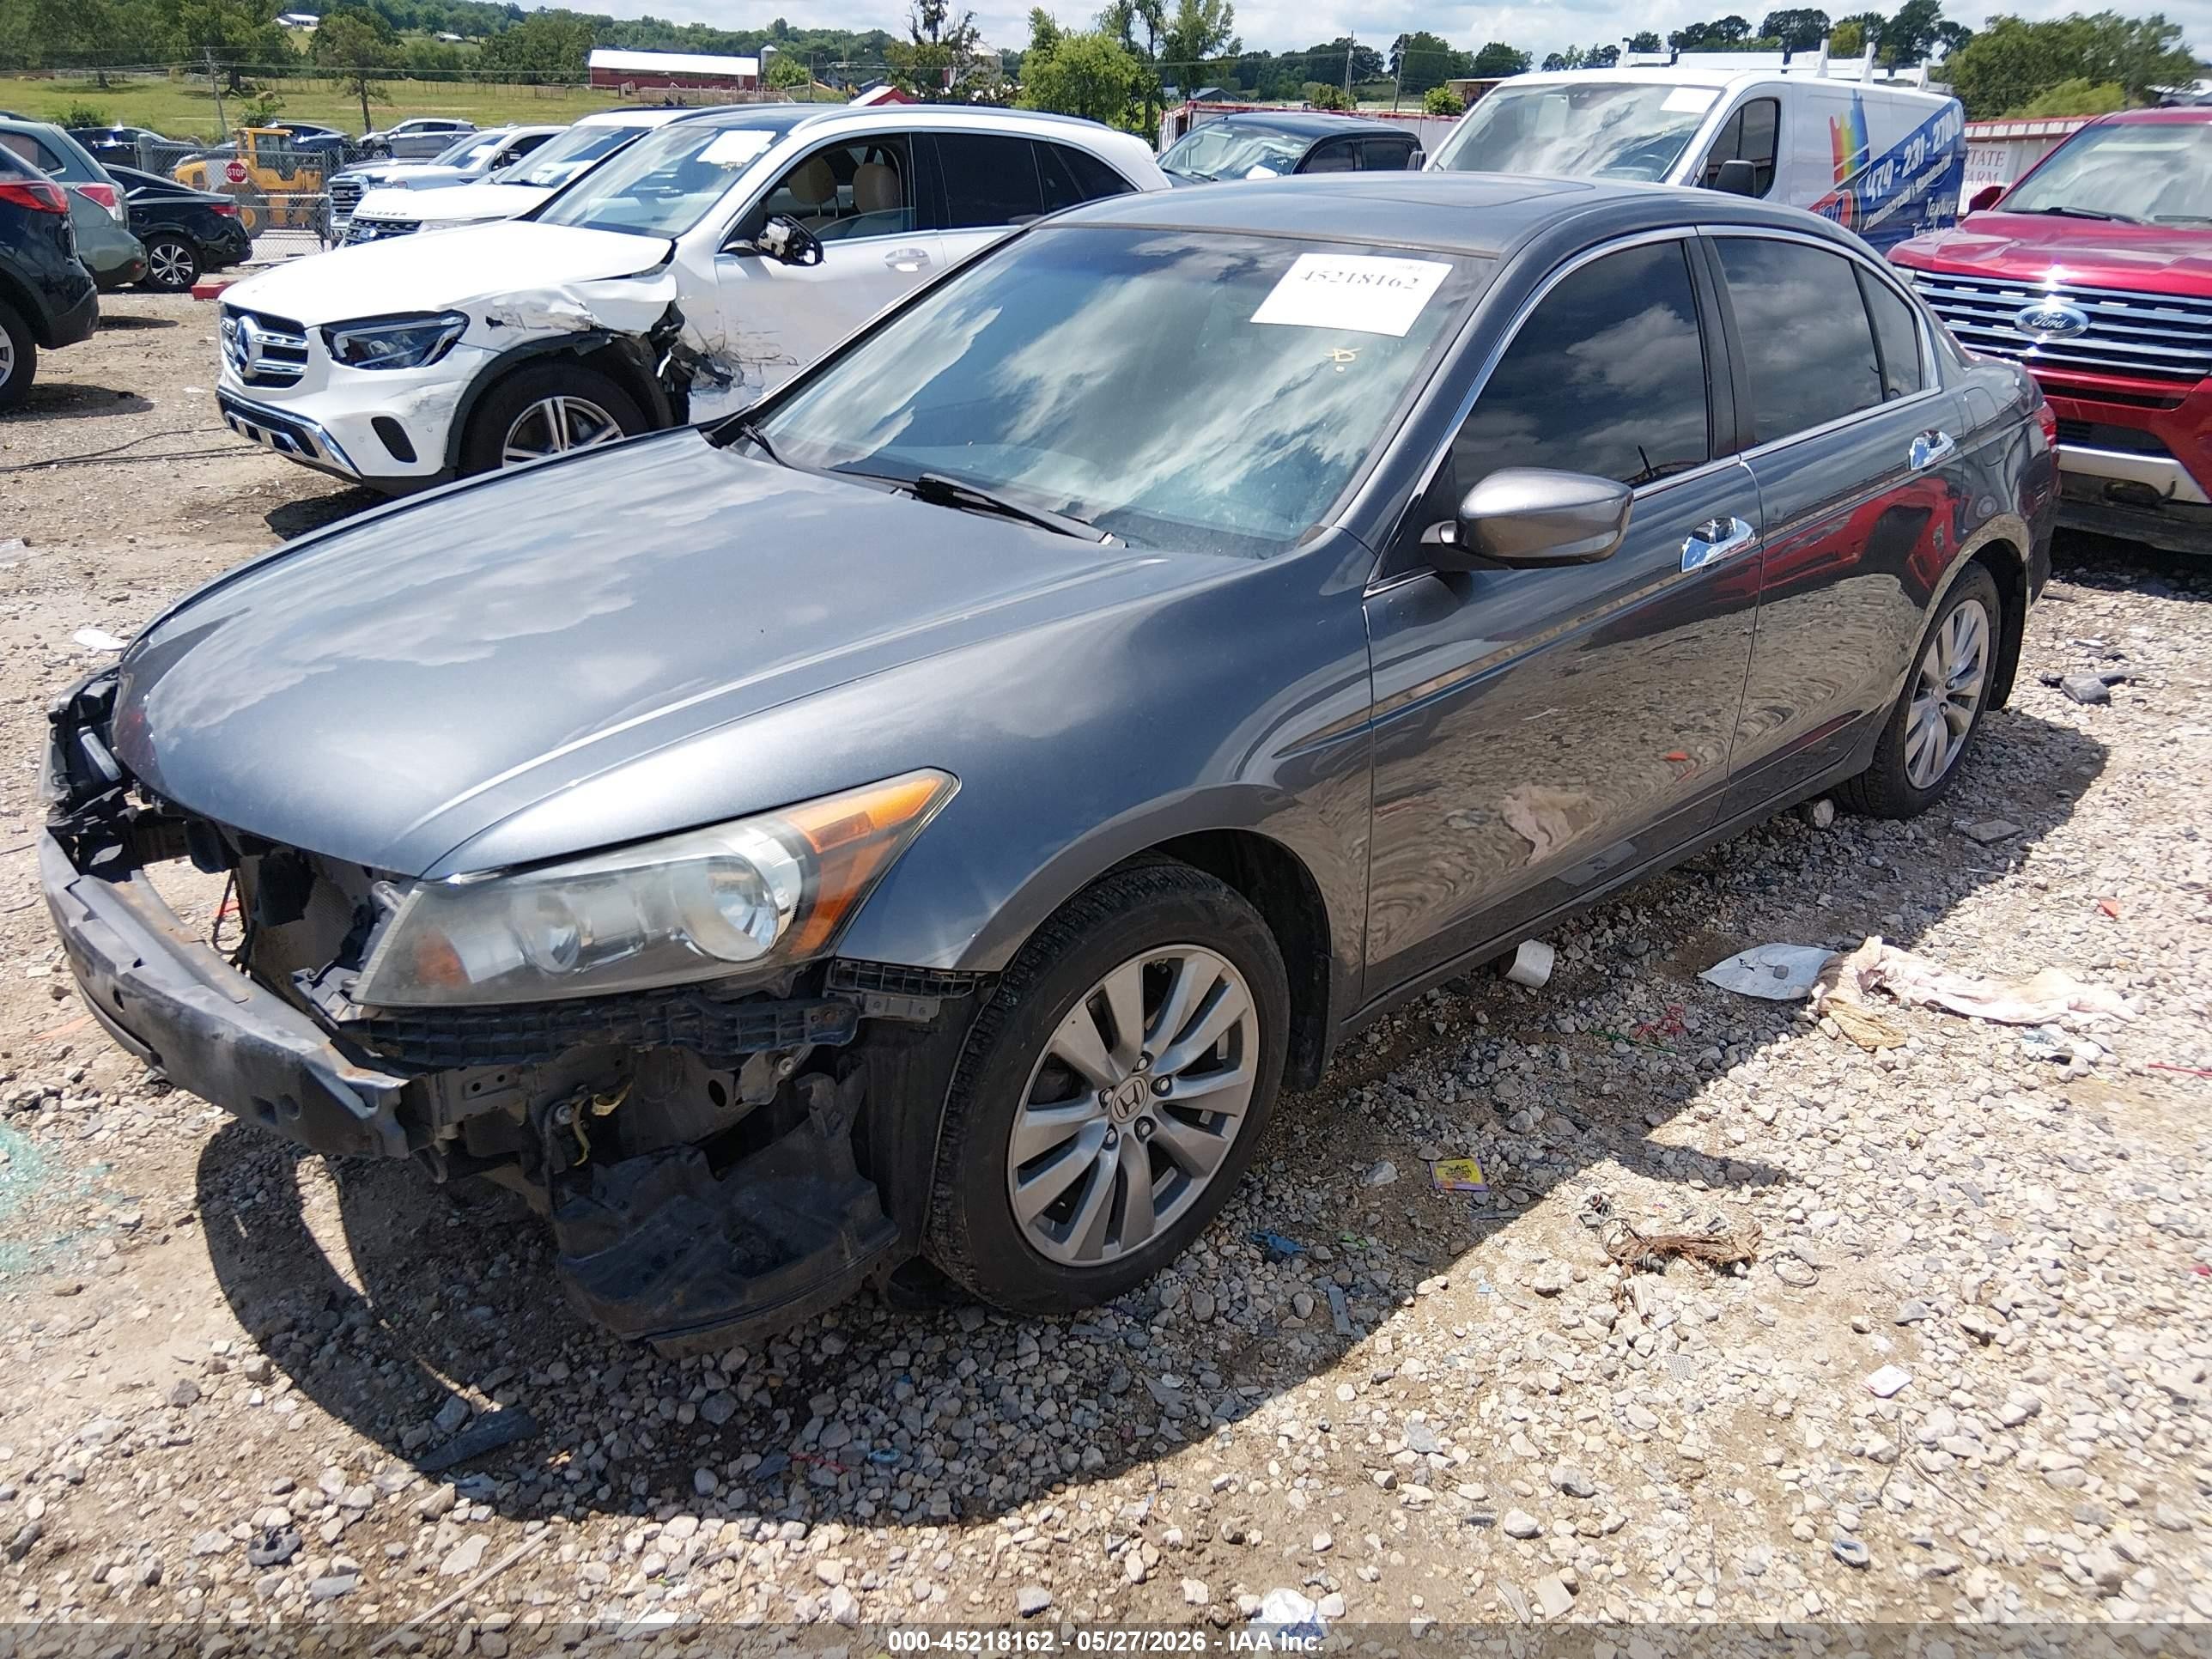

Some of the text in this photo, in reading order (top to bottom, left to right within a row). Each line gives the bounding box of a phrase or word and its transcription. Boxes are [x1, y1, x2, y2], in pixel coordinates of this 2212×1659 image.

[227, 167, 246, 177] STOP
[1300, 270, 1419, 289] 45218162
[2031, 312, 2069, 329] Ford
